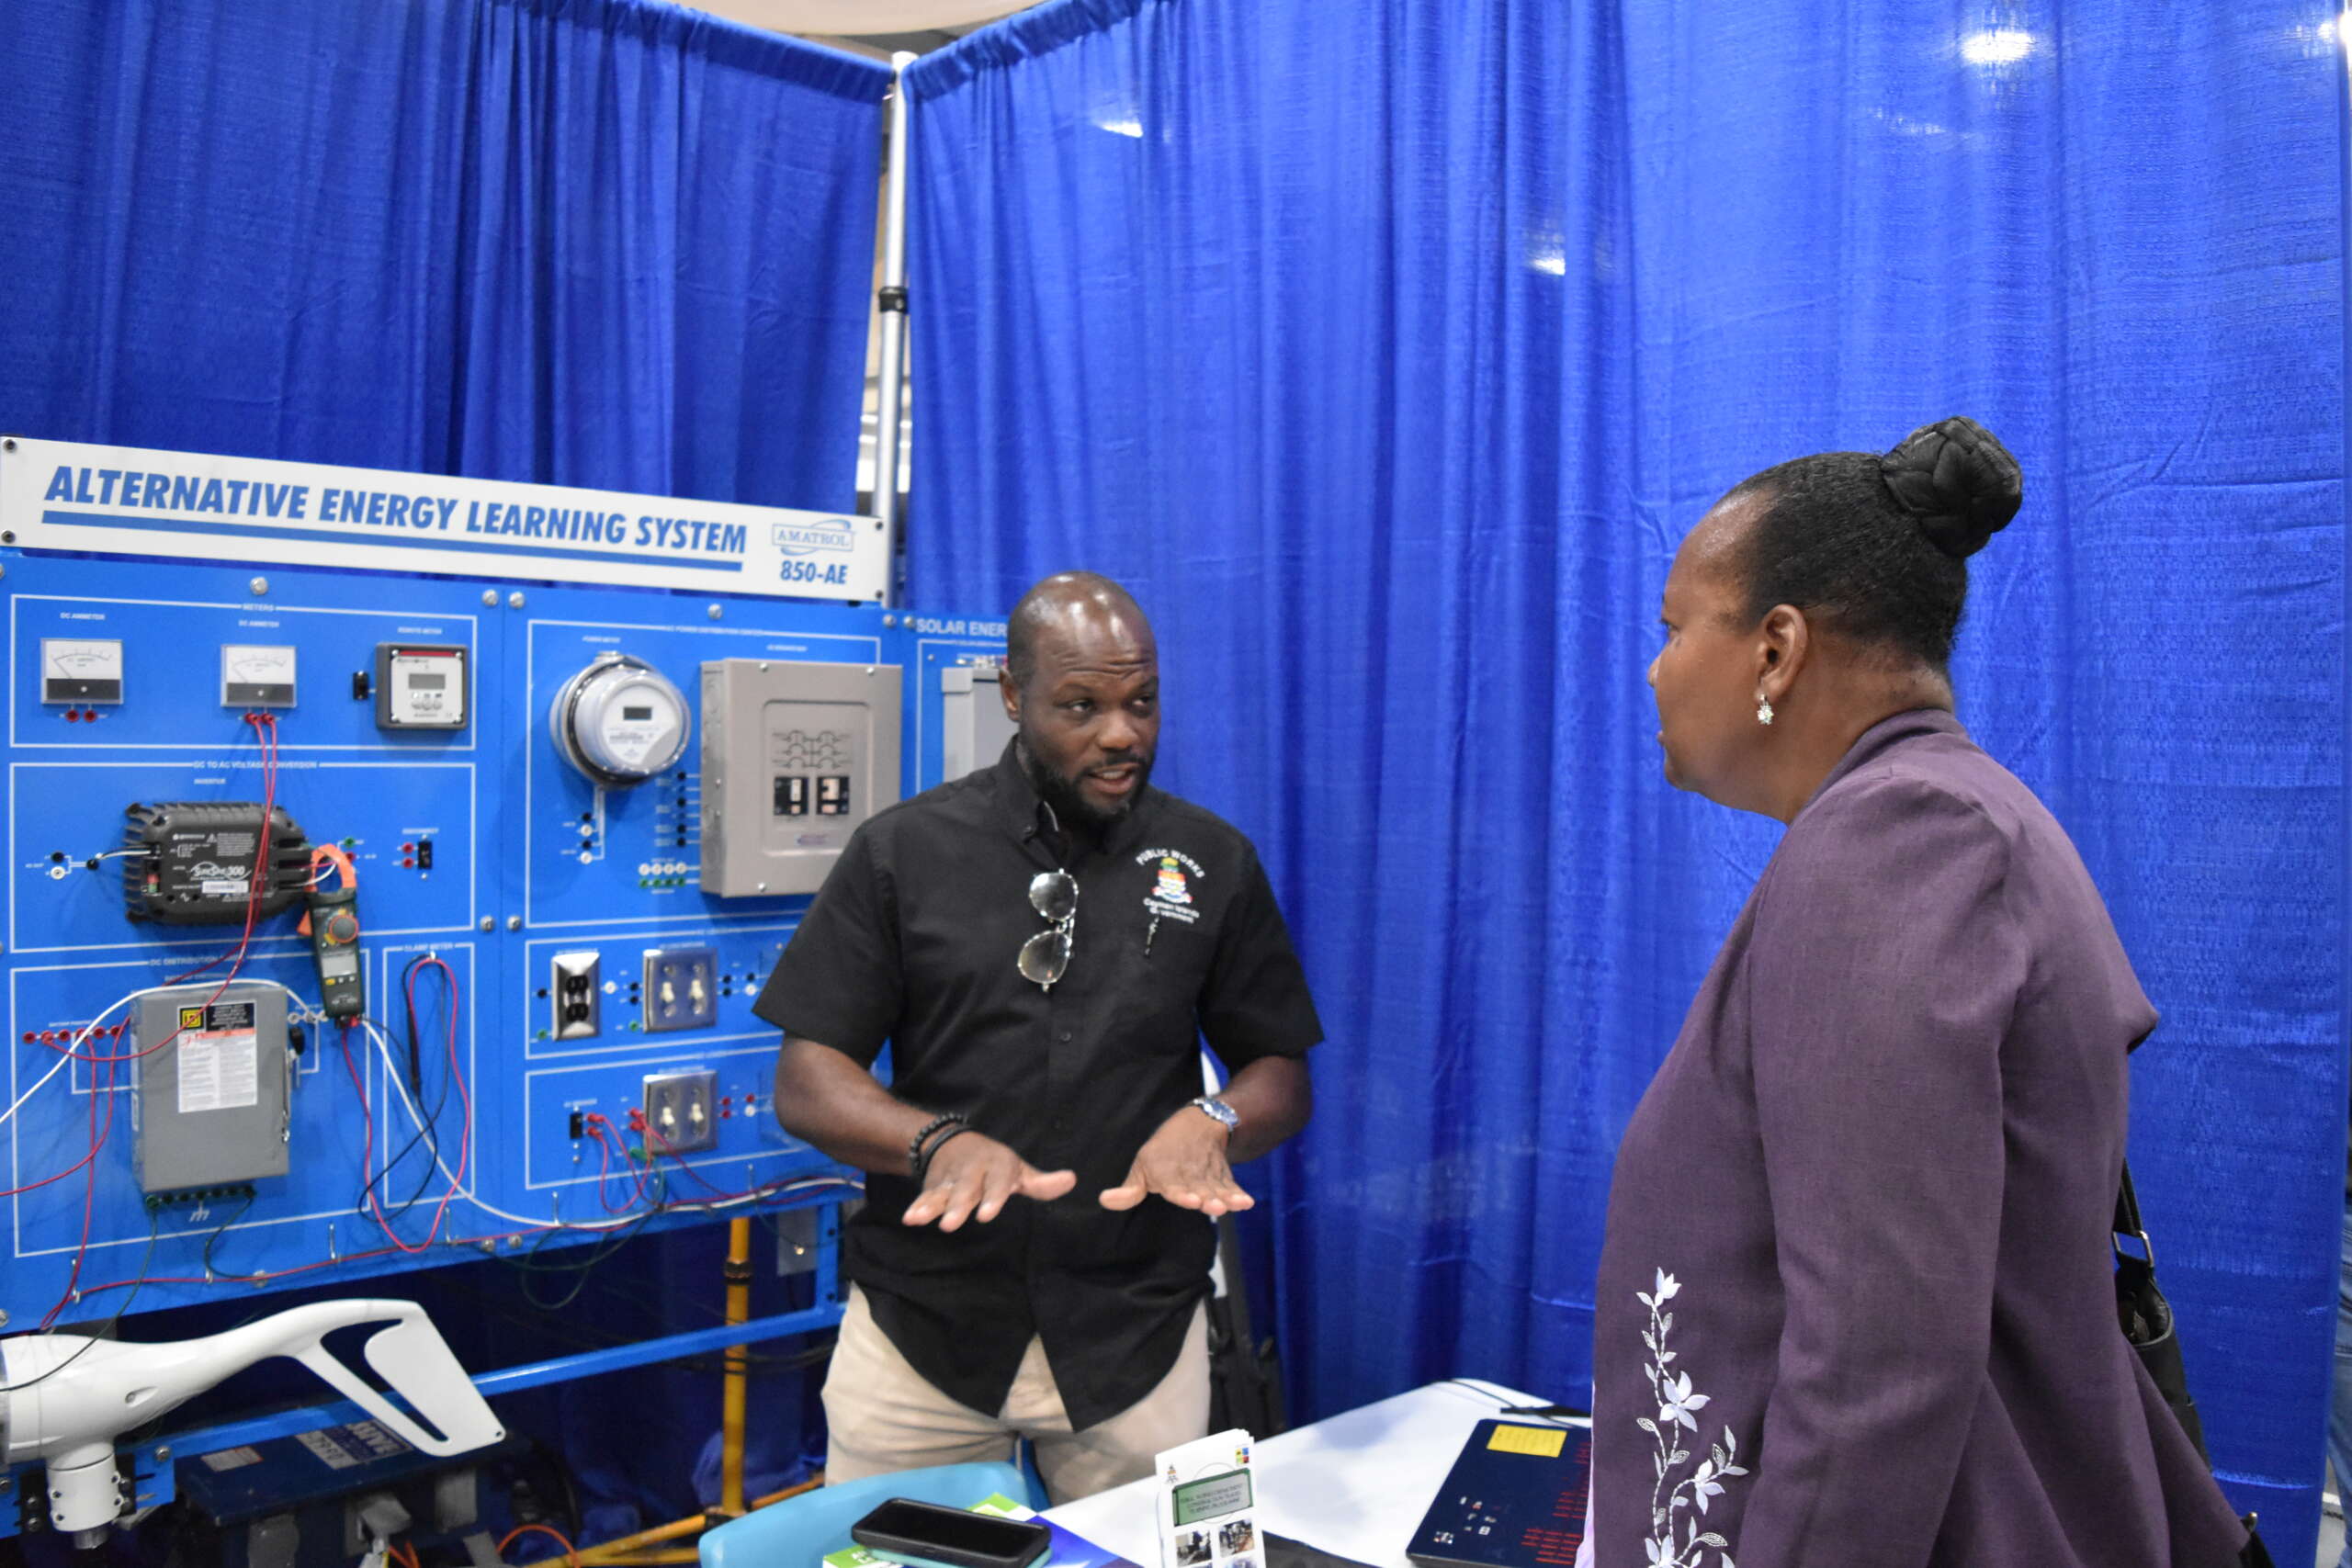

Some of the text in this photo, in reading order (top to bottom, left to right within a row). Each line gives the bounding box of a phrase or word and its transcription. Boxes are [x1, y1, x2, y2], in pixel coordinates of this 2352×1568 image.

[44, 466, 747, 554] ALTERNATIVE ENERGY LEARNING SYSTEM
[777, 529, 850, 547] AMATROL
[779, 559, 848, 584] 850-AE
[916, 617, 1008, 637] SOLAR ENER
